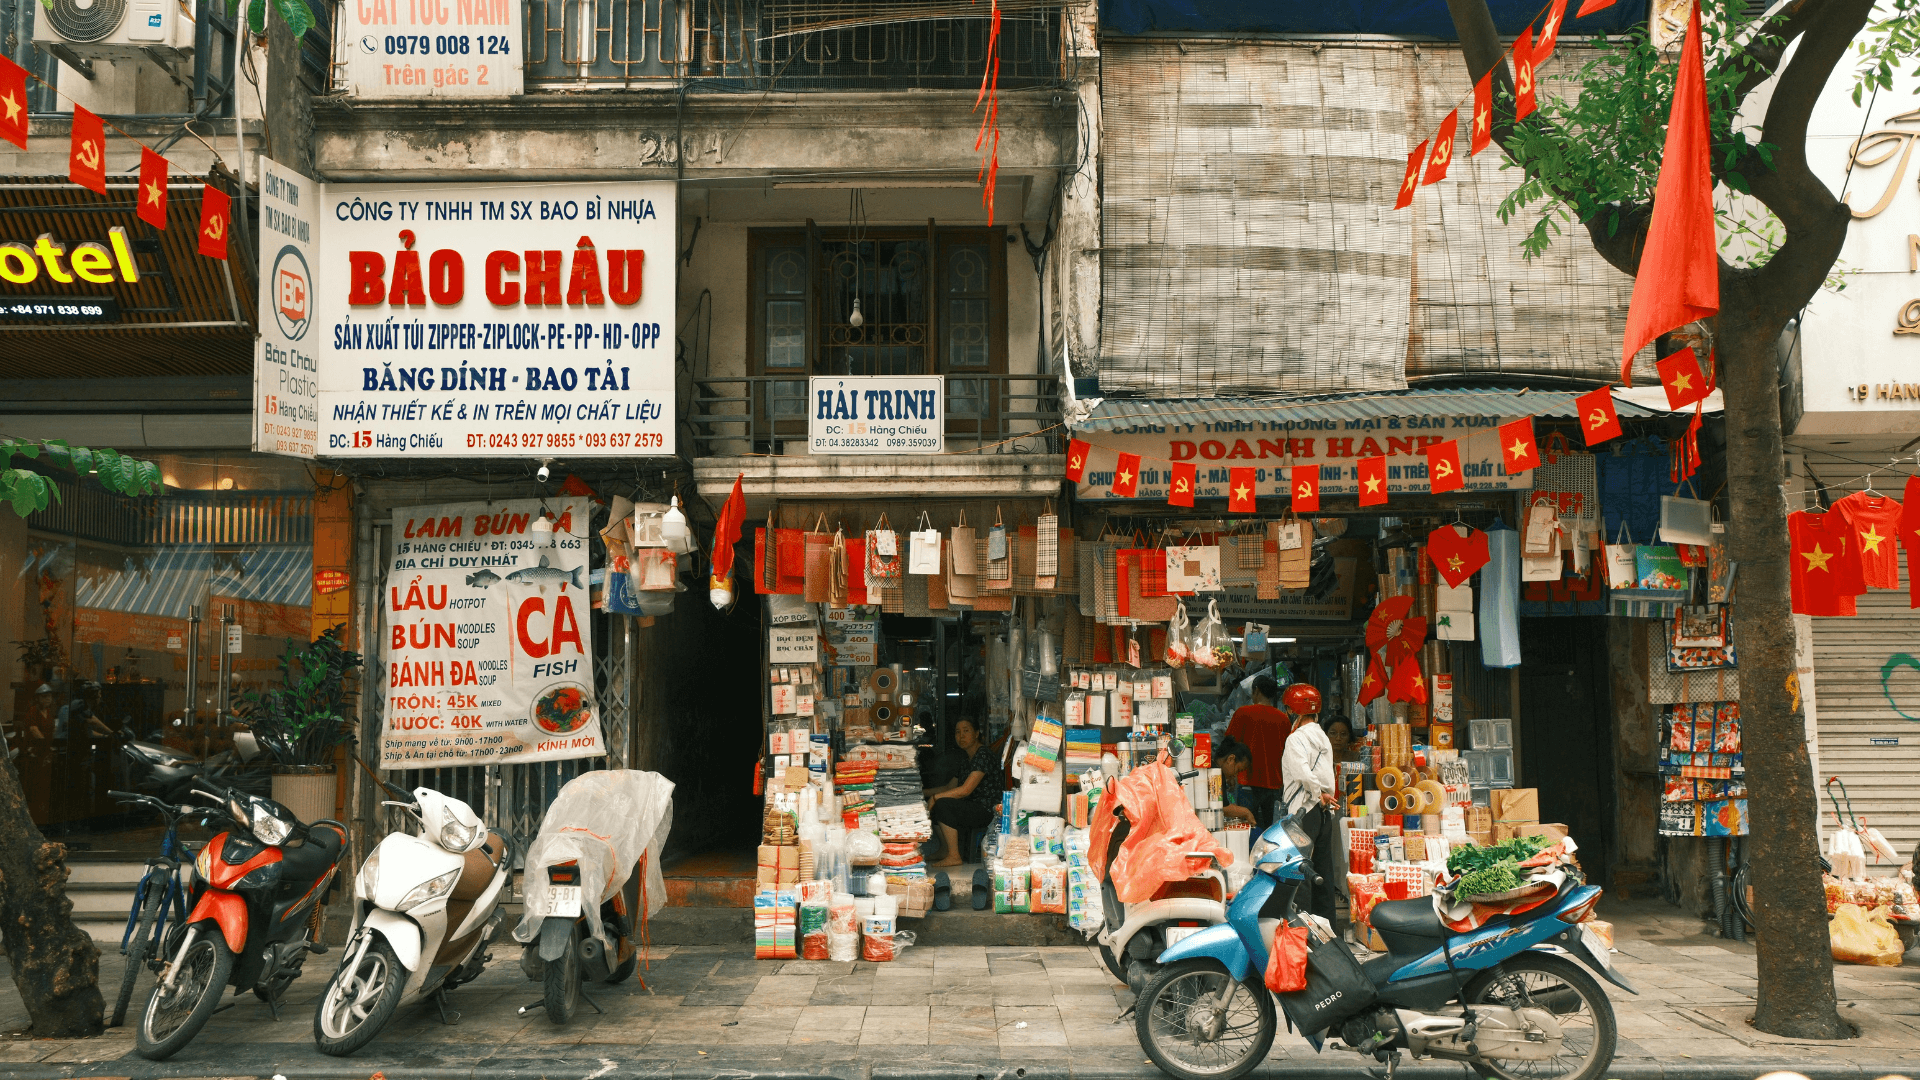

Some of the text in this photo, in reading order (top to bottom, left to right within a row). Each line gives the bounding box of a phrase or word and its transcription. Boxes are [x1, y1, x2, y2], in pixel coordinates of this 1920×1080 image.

[384, 35, 510, 55] 0979 008 124
[383, 64, 489, 88] Trên gác 2
[336, 194, 656, 224] CÔNG TY TNHH TM SX BAO BÌ NHỰA
[348, 229, 645, 306] BẢO CHÂU
[10, 305, 33, 315] +84
[33, 305, 55, 315] 971
[57, 305, 80, 315] 838
[80, 305, 103, 316] 699
[334, 314, 362, 350] SẢN
[366, 318, 400, 350] XUẤT
[404, 318, 424, 350] TÚI
[265, 342, 317, 373] Bảo Châu
[280, 368, 317, 398] Plastic
[362, 358, 630, 391] BĂNG DÍNH BAO TẢI
[1876, 378, 1920, 400] HÀN
[264, 394, 317, 422] 15 Hàng Chiếu
[333, 398, 661, 424] NHẬN THIẾT KẾ & IN TRÊN MỌI CHẤT LIỆU
[817, 381, 936, 420] HẢI TRINH
[276, 425, 291, 437] 0243
[292, 427, 302, 438] 927
[826, 422, 927, 436] ĐC: 15 Hàng Chiếu
[277, 440, 314, 455] 093 637 2579
[352, 430, 373, 448] 15
[376, 434, 406, 451] Hàng
[410, 433, 443, 448] Chiếu
[467, 433, 486, 448] ĐT:
[489, 433, 518, 448] 0243
[521, 433, 544, 448] 927
[546, 433, 575, 448] 9855
[585, 433, 608, 448] 093
[610, 433, 632, 448] 637
[634, 433, 663, 448] 2579
[815, 439, 827, 447] ĐT:
[829, 438, 879, 447] 04.38283342
[1169, 437, 1316, 461] DOANH
[1140, 468, 1159, 484] TÚI
[1319, 463, 1341, 480] ÍNH
[1388, 465, 1401, 479] IN
[1464, 458, 1493, 478] CHẤT
[404, 516, 463, 539] LAM
[473, 507, 531, 536] BÚN
[396, 542, 411, 556] 15
[413, 542, 447, 554] HÀNG
[449, 540, 481, 553] CHIẾU
[490, 541, 507, 551] ĐT:
[510, 540, 535, 550] 0345
[560, 539, 581, 549] 663
[395, 552, 519, 571] ĐỊA CHỈ DUY NHẤT
[391, 574, 486, 612] LẨU HOTPOT
[516, 581, 585, 659] CÁ
[828, 611, 845, 621] 400
[392, 617, 496, 650] BÚN NOODLES
[457, 638, 480, 649] SOUP
[390, 655, 508, 688] BÁNH ĐA NOODLES
[533, 659, 578, 678] FISH
[479, 675, 497, 686] SOUP
[390, 693, 502, 712] TRỘN: 45K MIXED
[390, 714, 528, 731] NƯỚC: 40K WITH WATER
[385, 739, 402, 750] Ship
[404, 740, 426, 749] mang
[537, 736, 595, 752] KÍNH MỜI
[384, 751, 402, 761] Ship
[404, 751, 411, 759] &
[1315, 991, 1342, 1011] PEDRO
